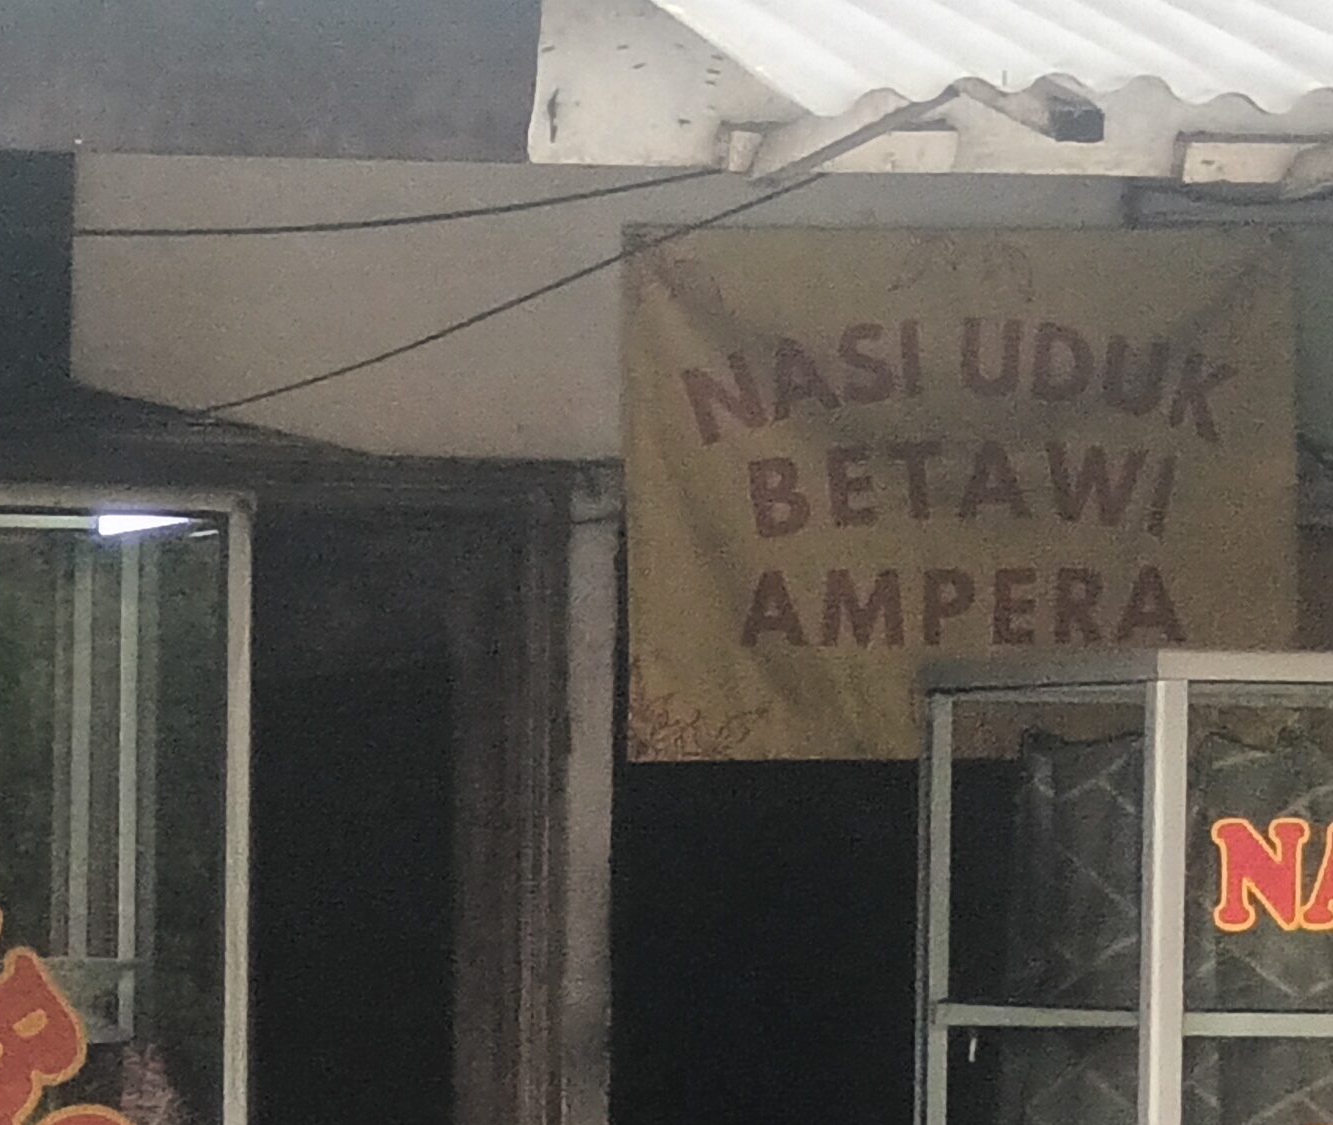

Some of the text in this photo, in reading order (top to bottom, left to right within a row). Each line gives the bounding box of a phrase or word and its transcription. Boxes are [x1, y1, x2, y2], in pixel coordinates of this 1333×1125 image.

[680, 317, 1234, 446] NASI UDUK
[748, 439, 1179, 540] BETAWI
[740, 566, 1187, 647] AMPERA
